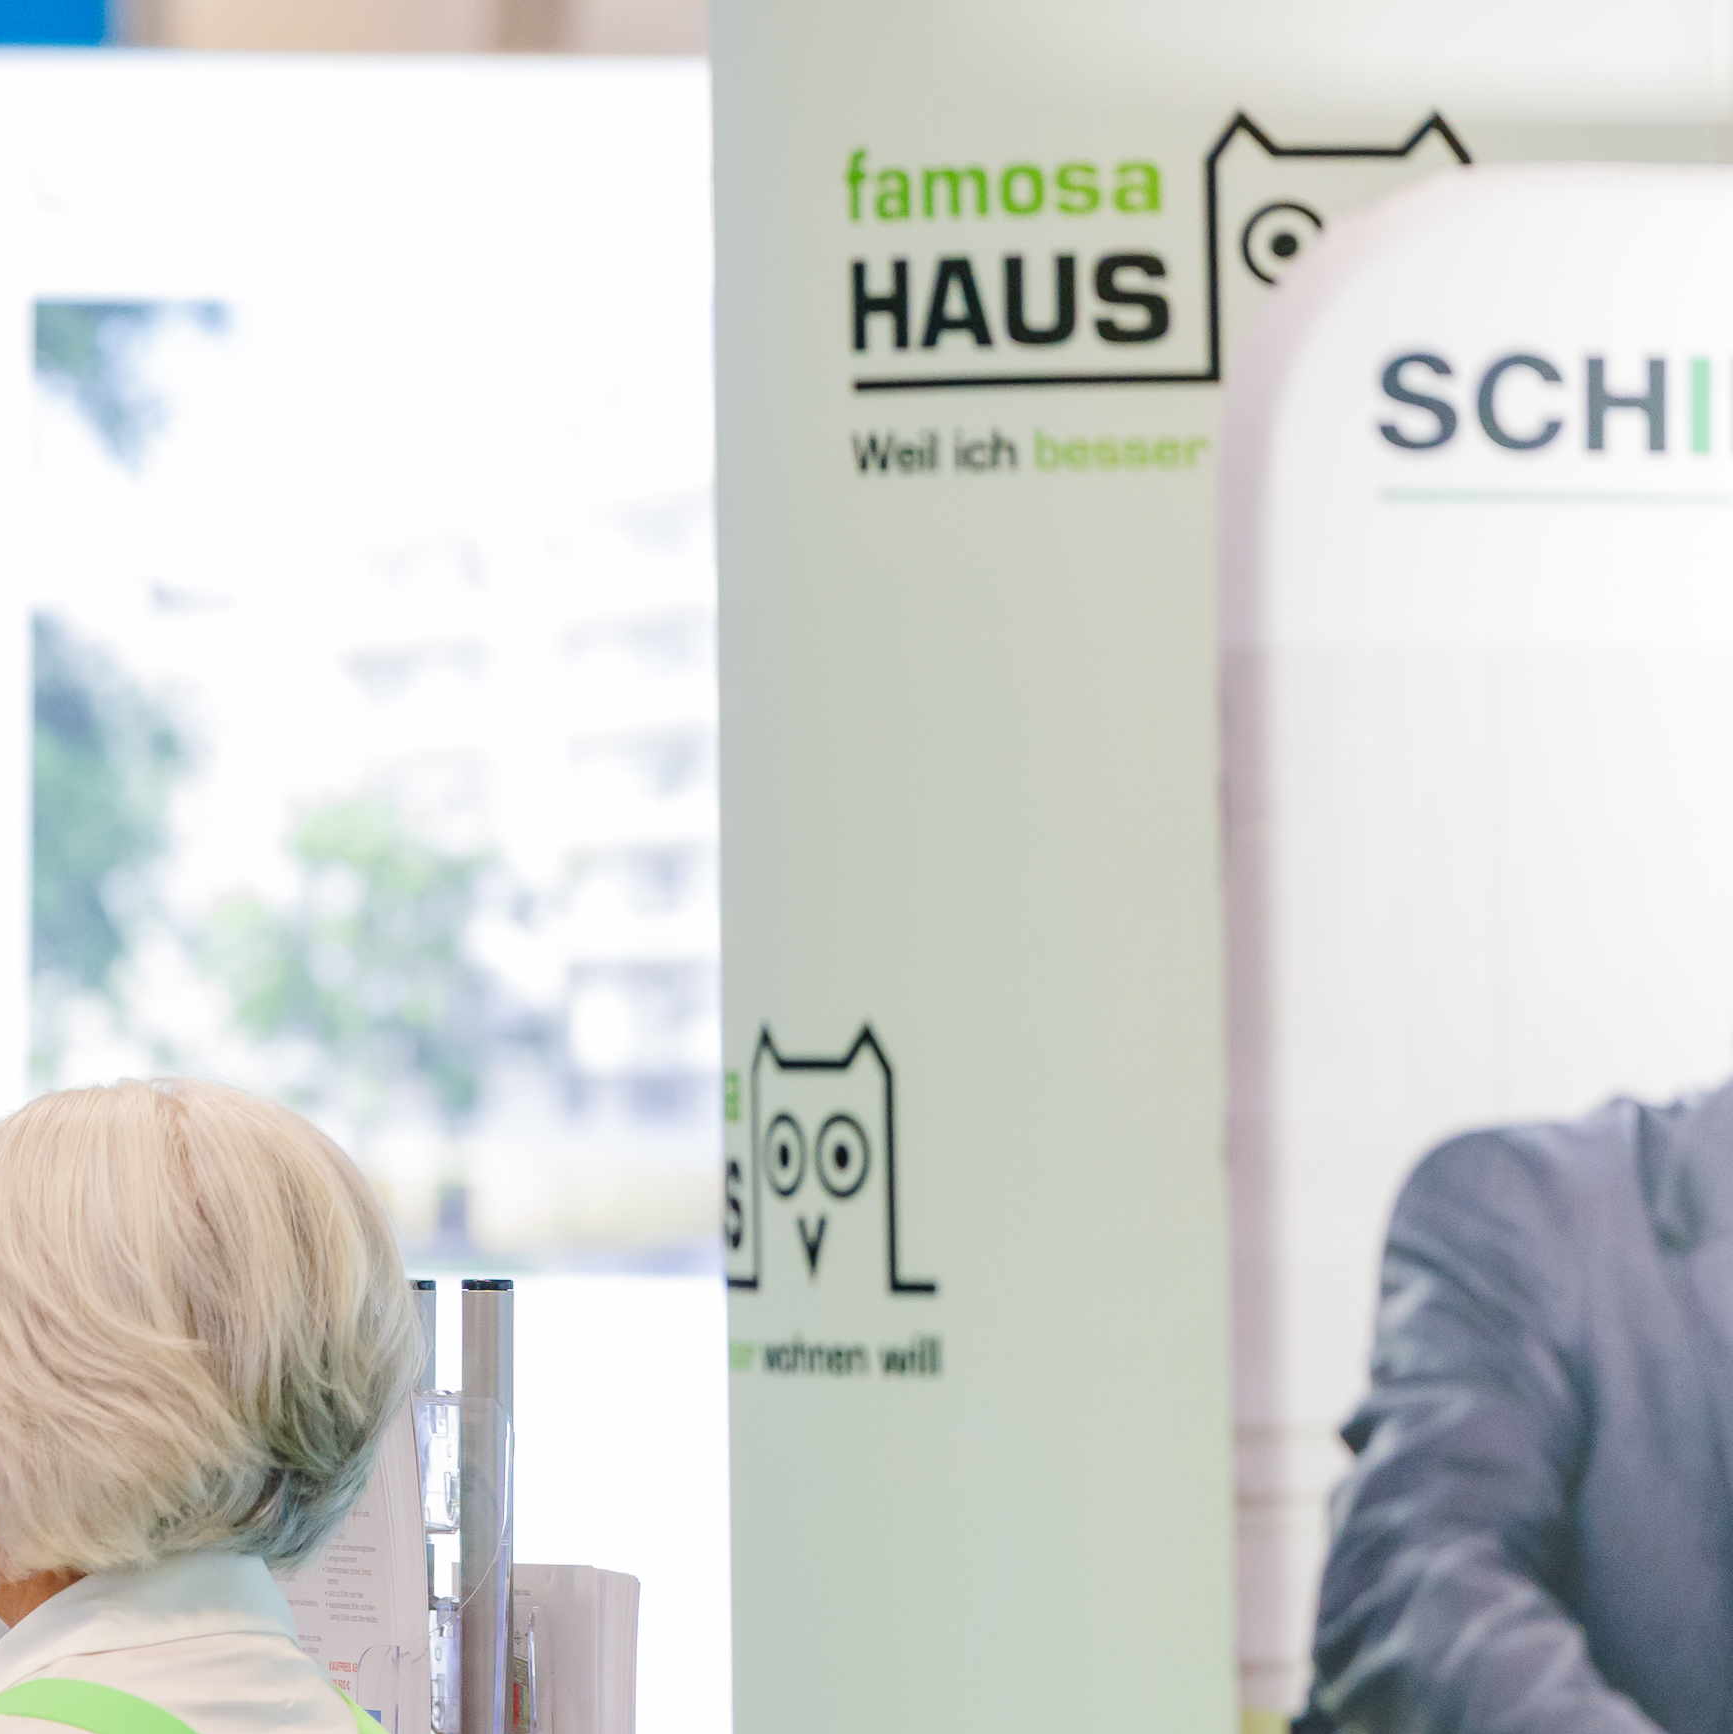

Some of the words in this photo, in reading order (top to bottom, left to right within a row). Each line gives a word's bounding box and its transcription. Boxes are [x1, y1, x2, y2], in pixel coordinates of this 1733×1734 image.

[844, 147, 1163, 222] famosa
[851, 252, 1173, 353] HAUS
[1377, 352, 1733, 456] SCHI
[851, 430, 939, 477] Weil
[953, 427, 1017, 472] ich
[1034, 426, 1211, 474] besser
[762, 1332, 870, 1375] wohnen
[879, 1334, 943, 1376] will
